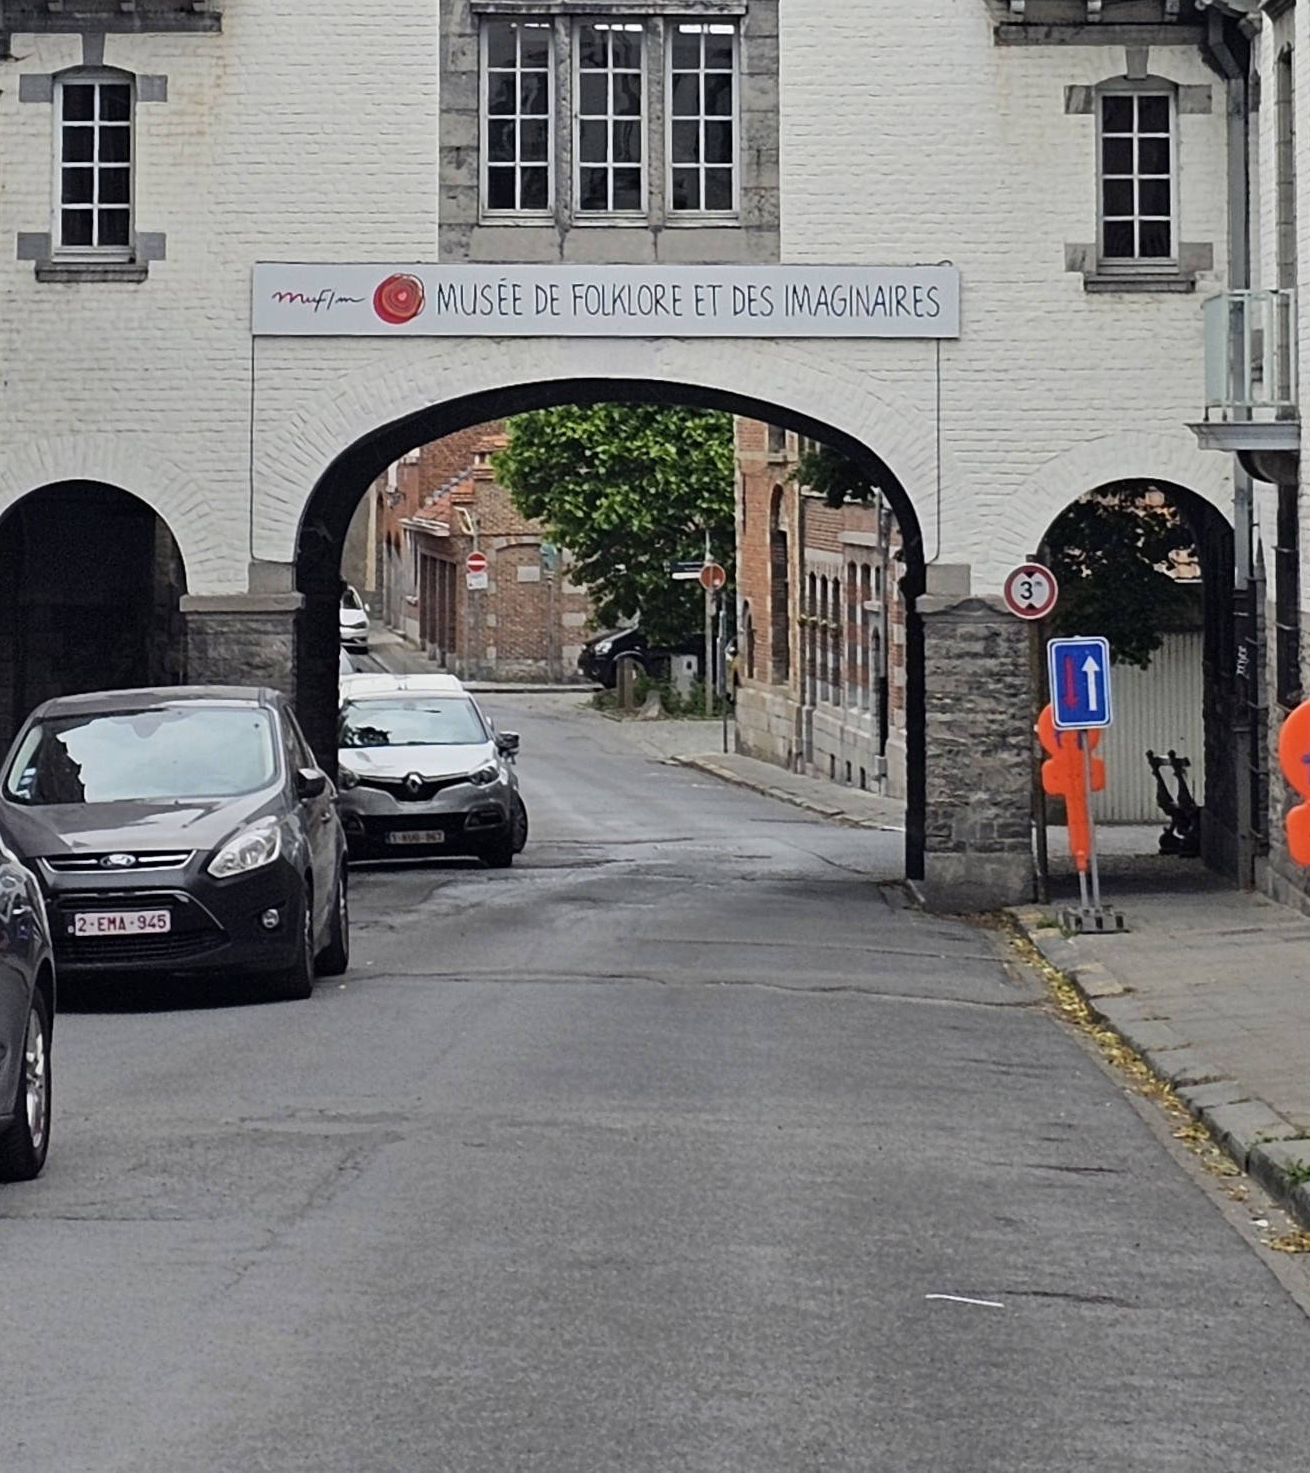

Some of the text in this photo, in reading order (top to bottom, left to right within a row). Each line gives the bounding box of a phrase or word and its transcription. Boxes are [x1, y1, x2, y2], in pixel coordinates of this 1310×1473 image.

[437, 277, 941, 318] MUSÉE DE FOLKLORE ET DES IMAGINAIRES
